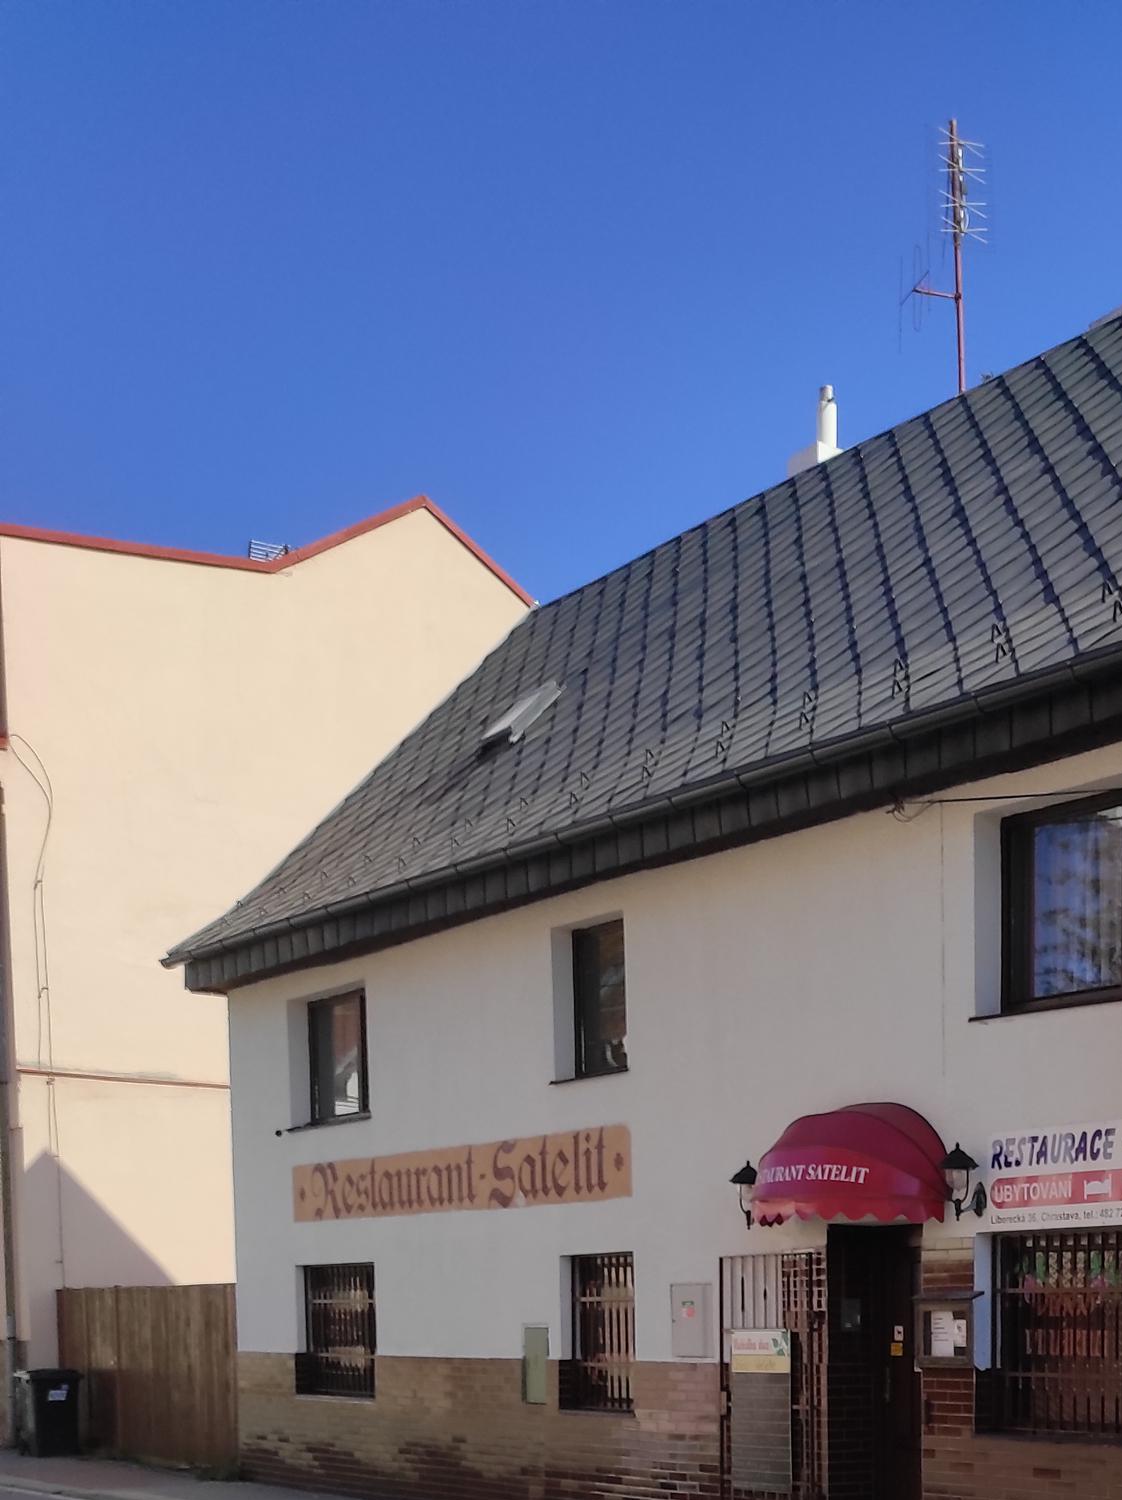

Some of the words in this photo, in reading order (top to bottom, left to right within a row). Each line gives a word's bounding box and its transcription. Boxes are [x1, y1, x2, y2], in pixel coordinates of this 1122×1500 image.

[991, 1128, 1116, 1170] RESTAURACE
[311, 1146, 477, 1219] Restaurant
[488, 1126, 609, 1208] Satelit
[806, 1163, 870, 1184] SATELIT
[994, 1177, 1072, 1203] UBYTOVÁNÍ
